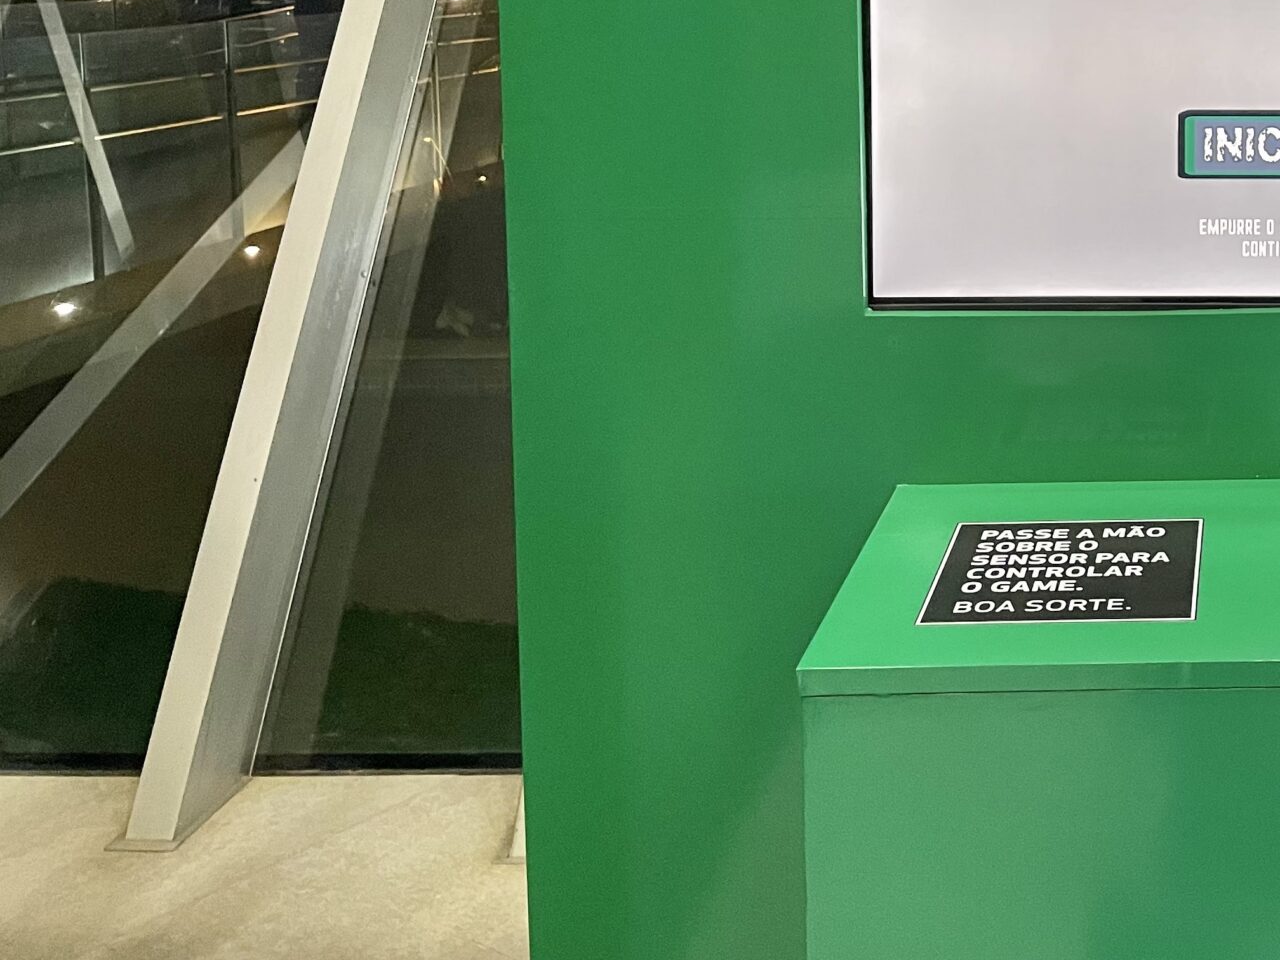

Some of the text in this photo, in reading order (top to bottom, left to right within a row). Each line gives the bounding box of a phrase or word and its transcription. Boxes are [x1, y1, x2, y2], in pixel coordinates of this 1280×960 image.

[1199, 218, 1261, 236] EMPURRE
[1266, 218, 1275, 236] O
[980, 525, 1166, 541] PASSE A MÃO
[975, 540, 1099, 553] SOBRE O
[970, 551, 1170, 566] SENSOR PARA
[966, 565, 1143, 580] CONTROLAR
[960, 580, 1084, 593] O GAME.
[952, 598, 1132, 614] BOA SORTE.
